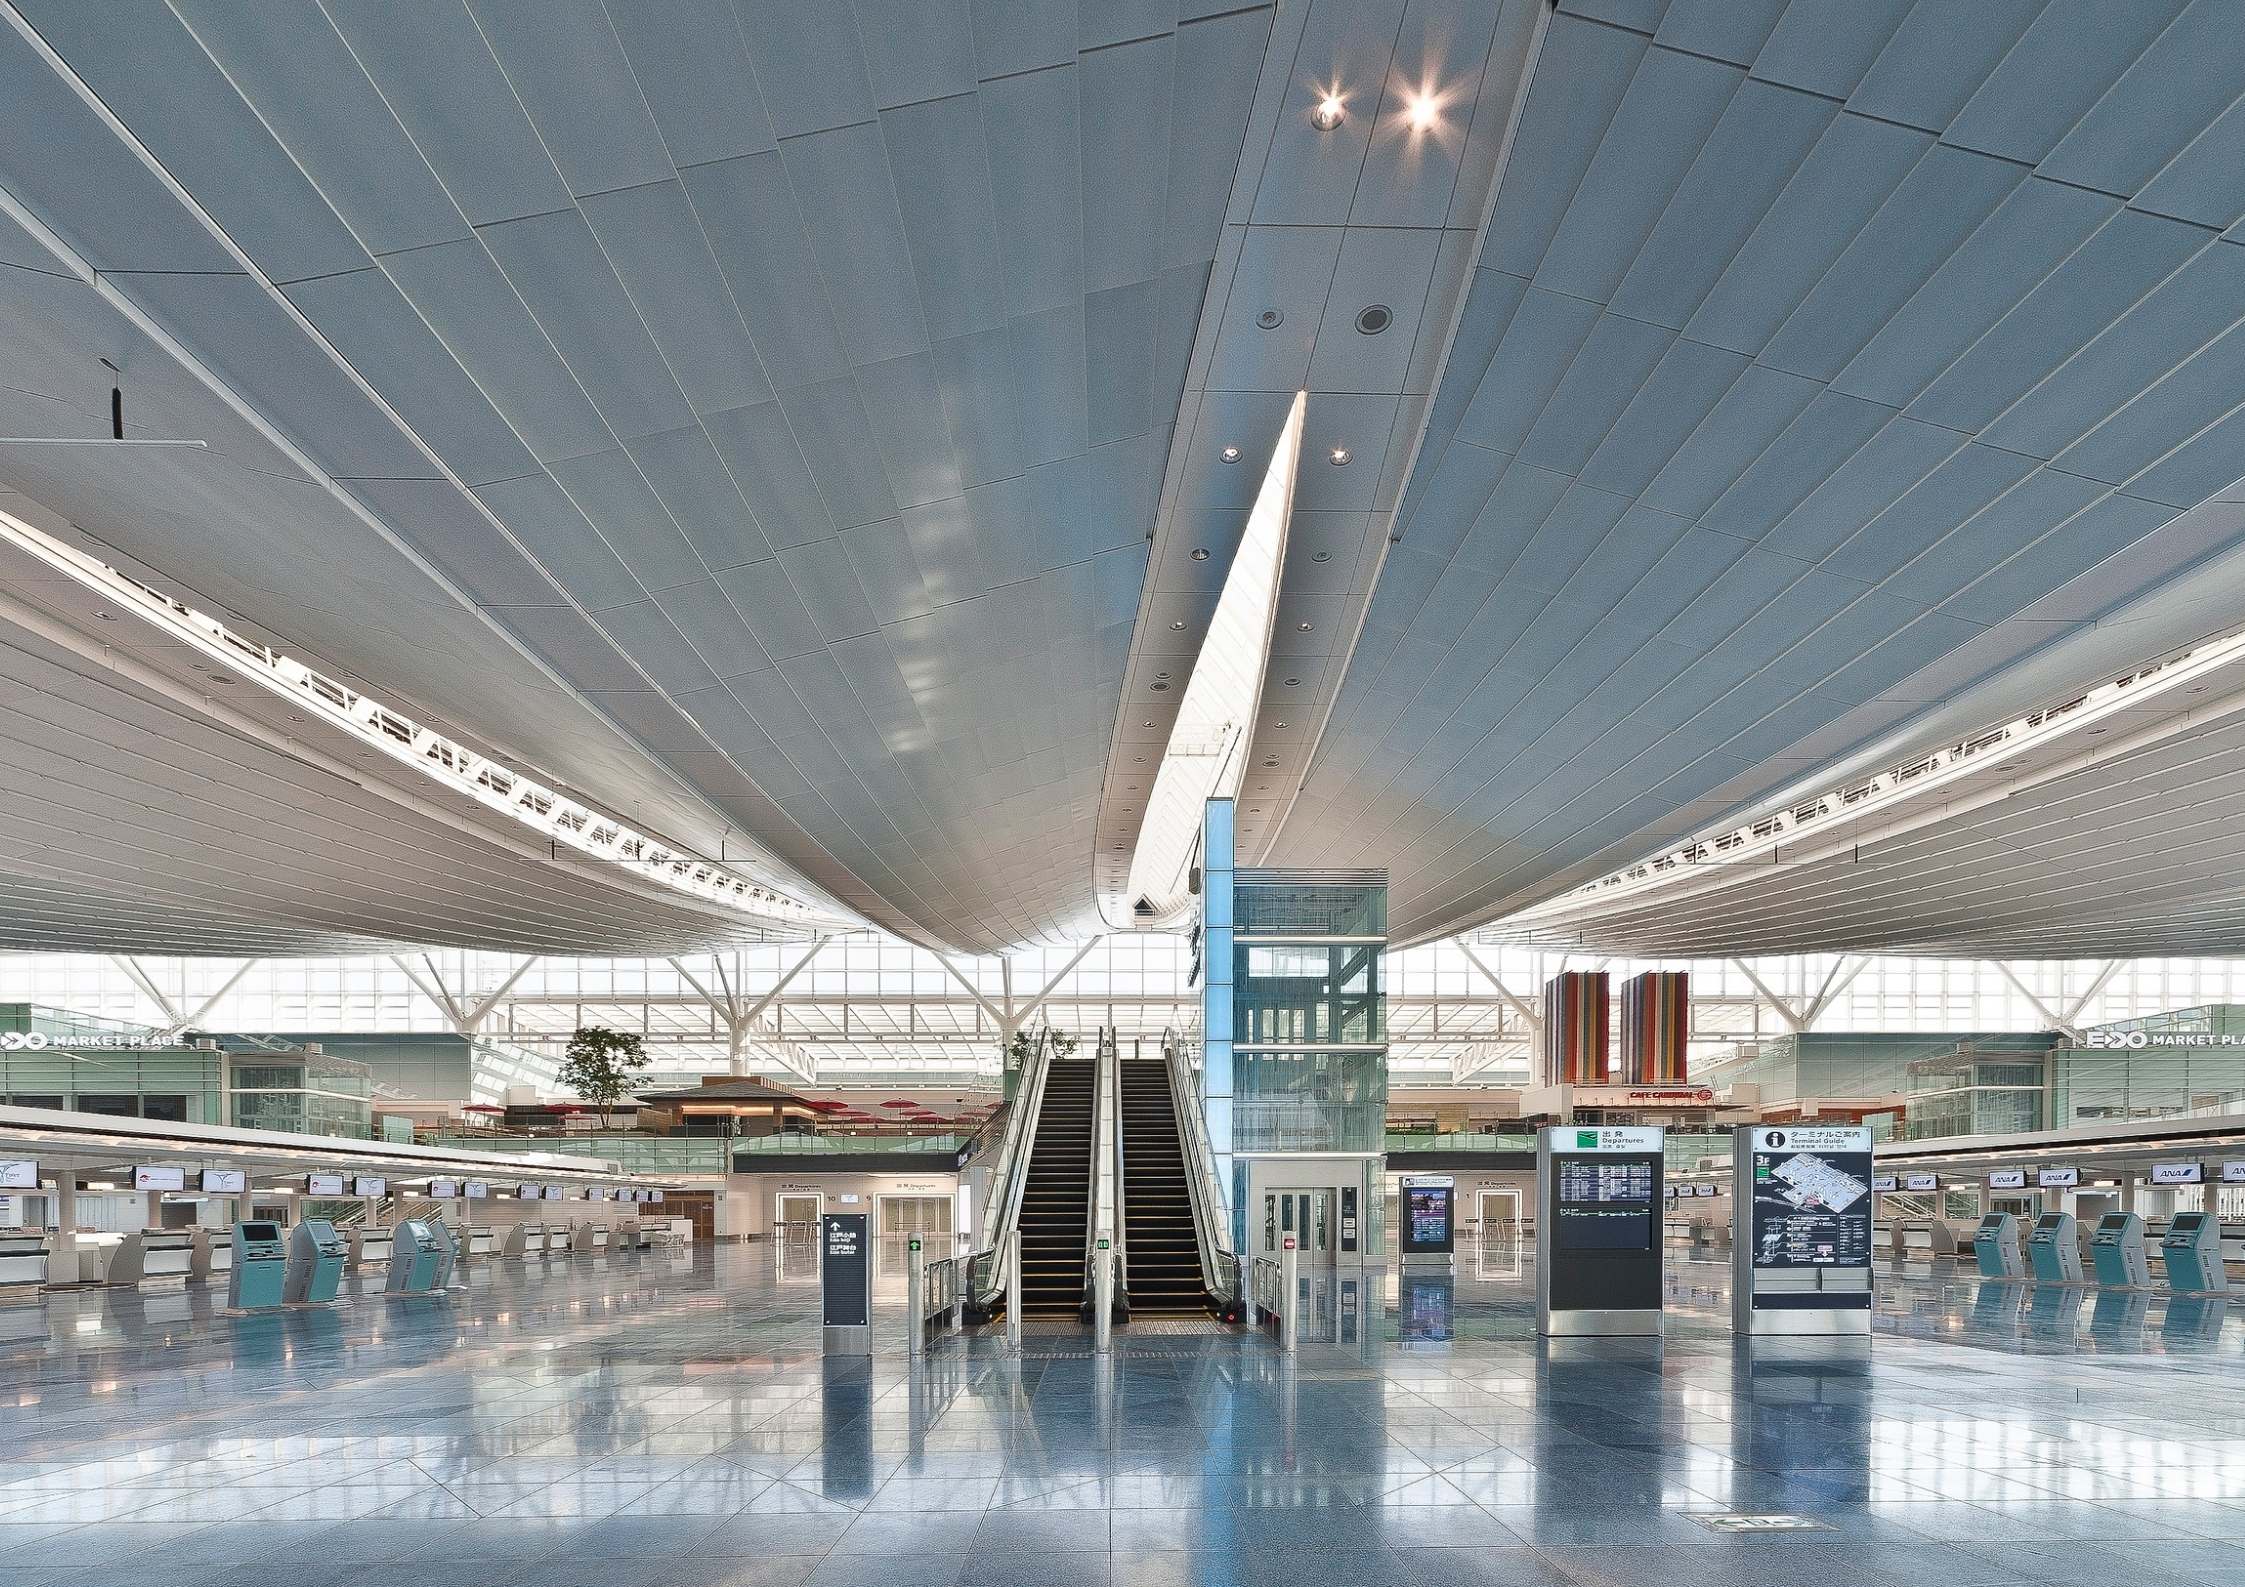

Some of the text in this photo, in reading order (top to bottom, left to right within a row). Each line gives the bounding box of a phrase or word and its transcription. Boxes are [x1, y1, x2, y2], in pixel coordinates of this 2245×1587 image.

[0, 1031, 184, 1050] DO MARKET PLACE
[2086, 1031, 2148, 1049] EDO
[2153, 1035, 2216, 1045] MARKET
[1602, 1130, 1623, 1138] 出発
